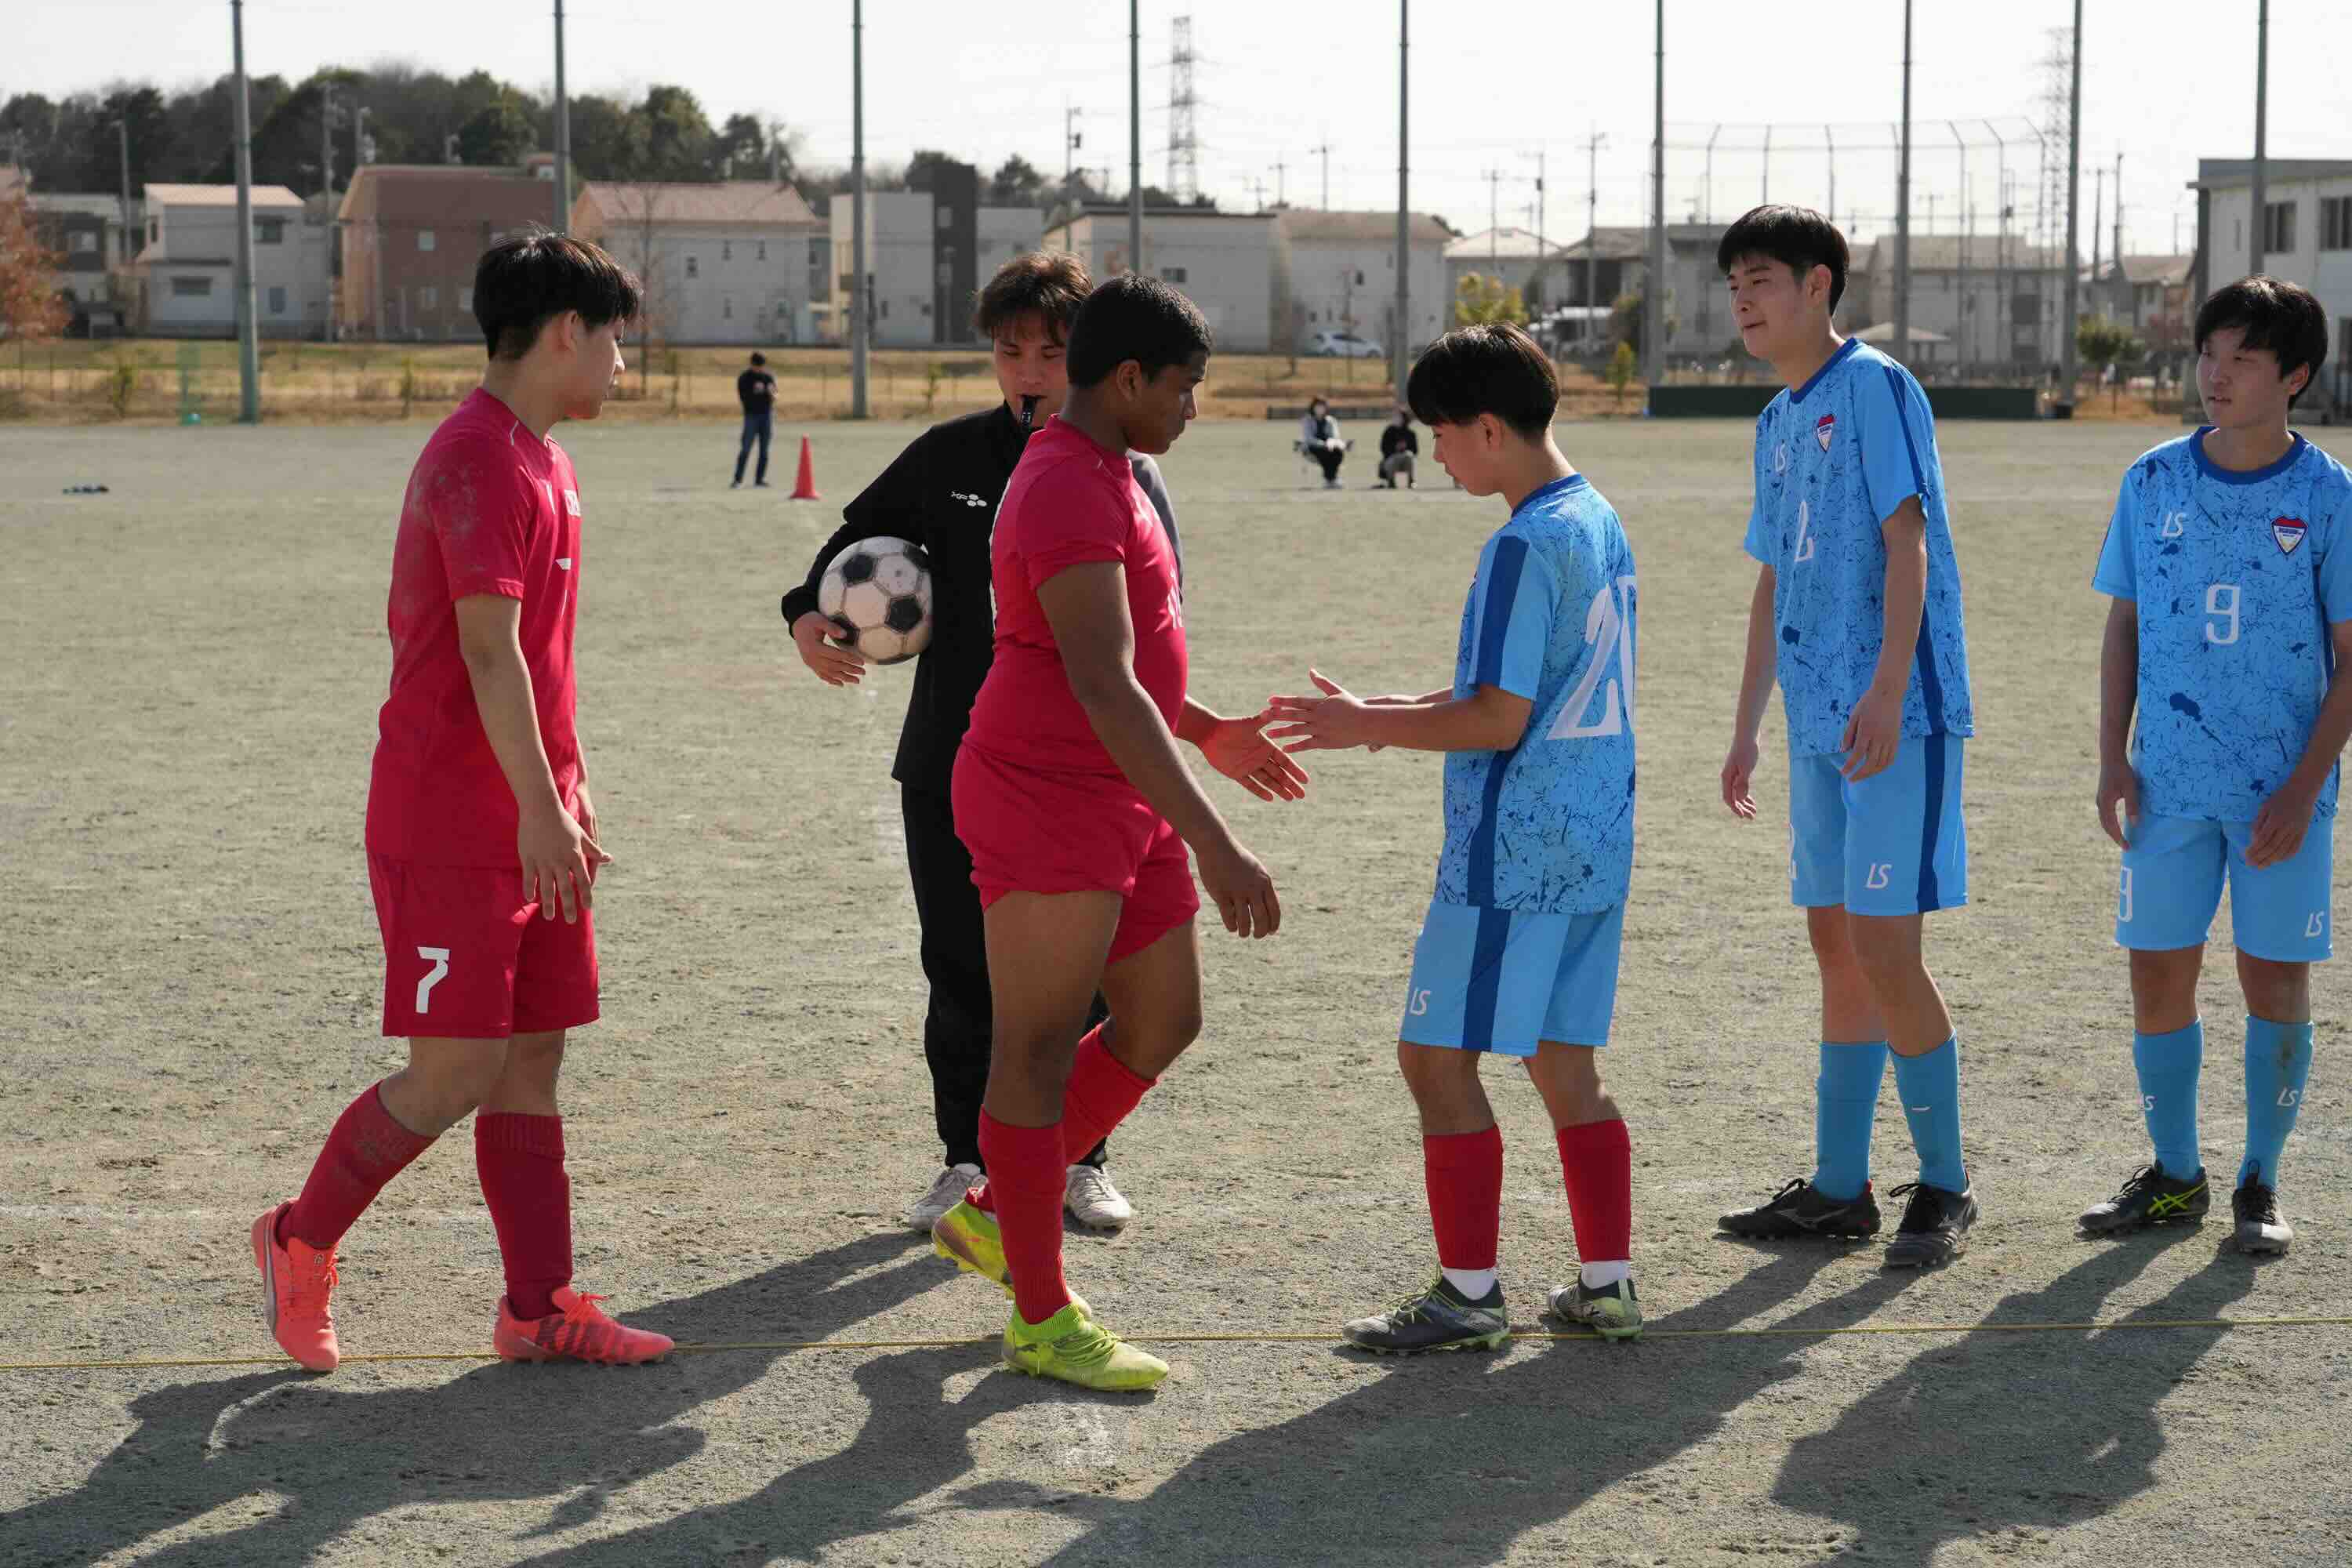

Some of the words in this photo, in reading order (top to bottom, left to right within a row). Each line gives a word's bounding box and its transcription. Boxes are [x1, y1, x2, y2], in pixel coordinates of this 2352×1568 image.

[2161, 511, 2187, 538] LS
[2205, 583, 2241, 644] 9
[1865, 862, 1892, 888] LS
[2304, 911, 2324, 937] LS
[416, 946, 450, 1014] 7
[1410, 988, 1430, 1015] LS
